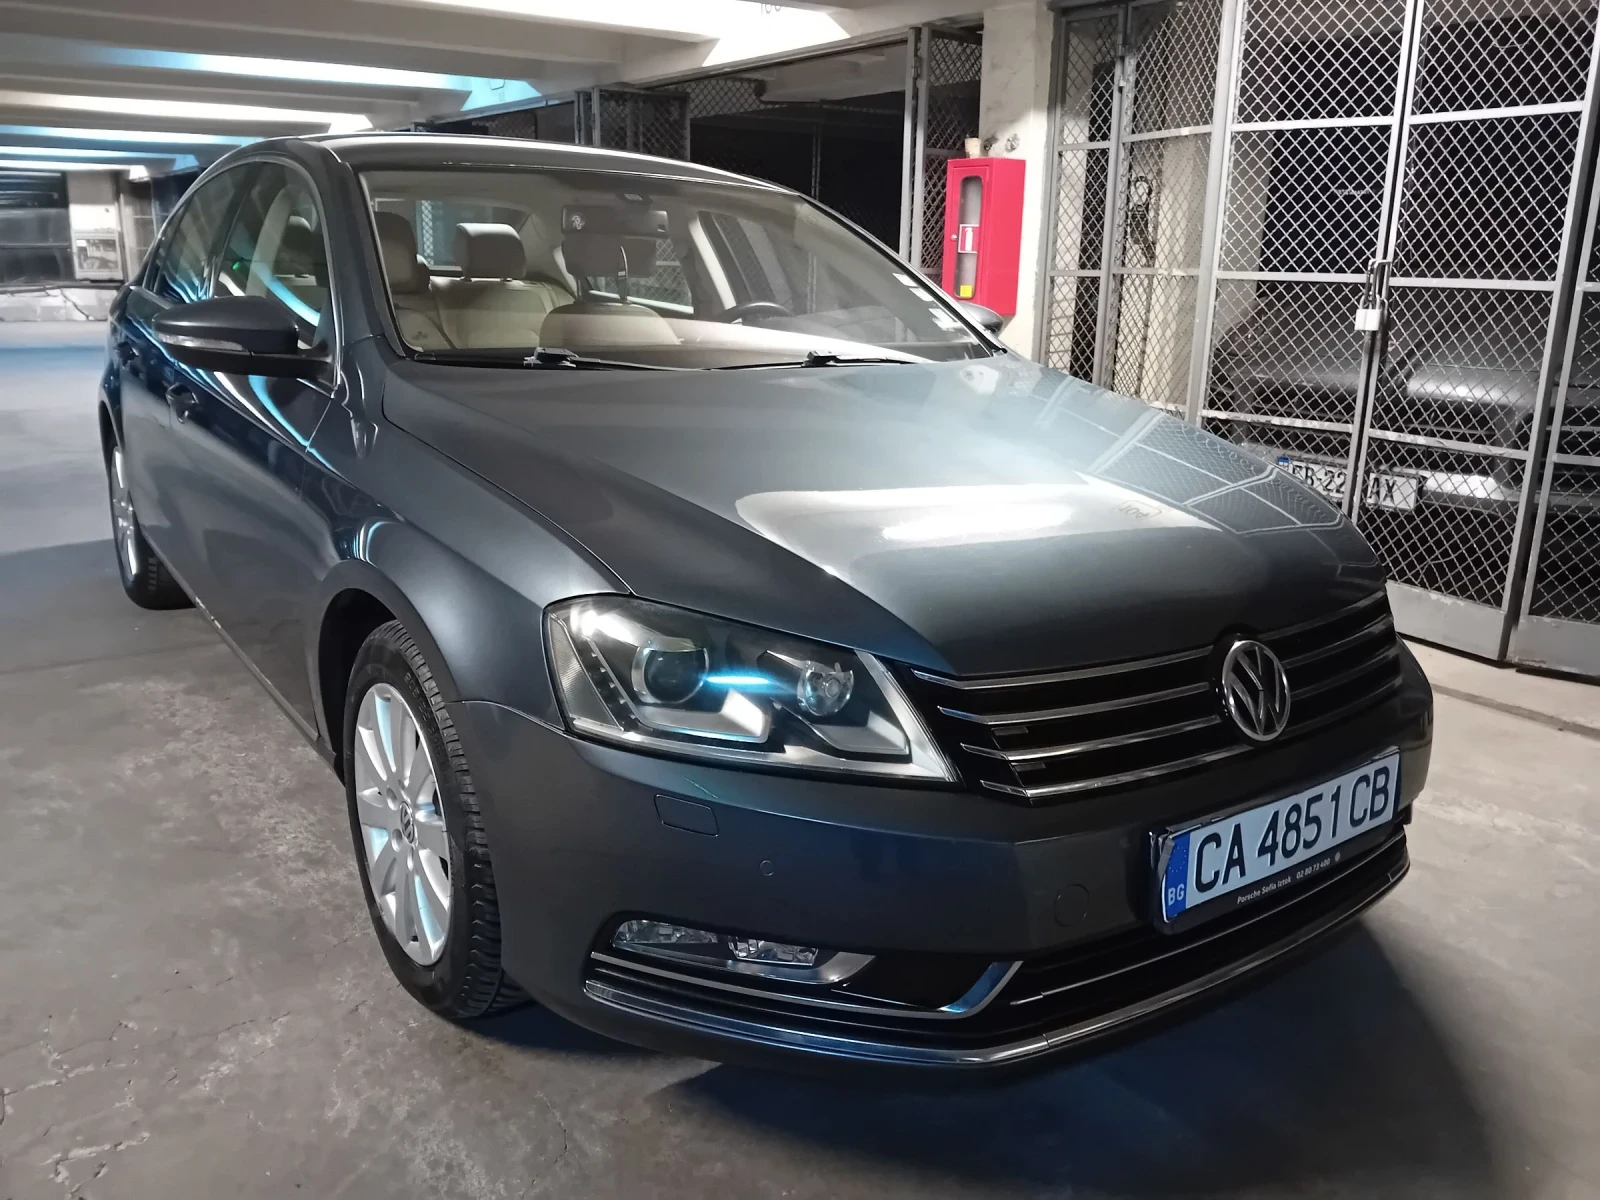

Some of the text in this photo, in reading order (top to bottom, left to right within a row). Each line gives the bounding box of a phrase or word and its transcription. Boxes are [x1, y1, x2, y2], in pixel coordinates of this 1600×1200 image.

[1195, 766, 1390, 893] CA 4851 CB
[1168, 883, 1185, 906] BG
[1237, 889, 1261, 904] Porsche
[1261, 882, 1277, 895] Sofia
[1277, 875, 1292, 887] Iztok
[1296, 870, 1304, 879] 02
